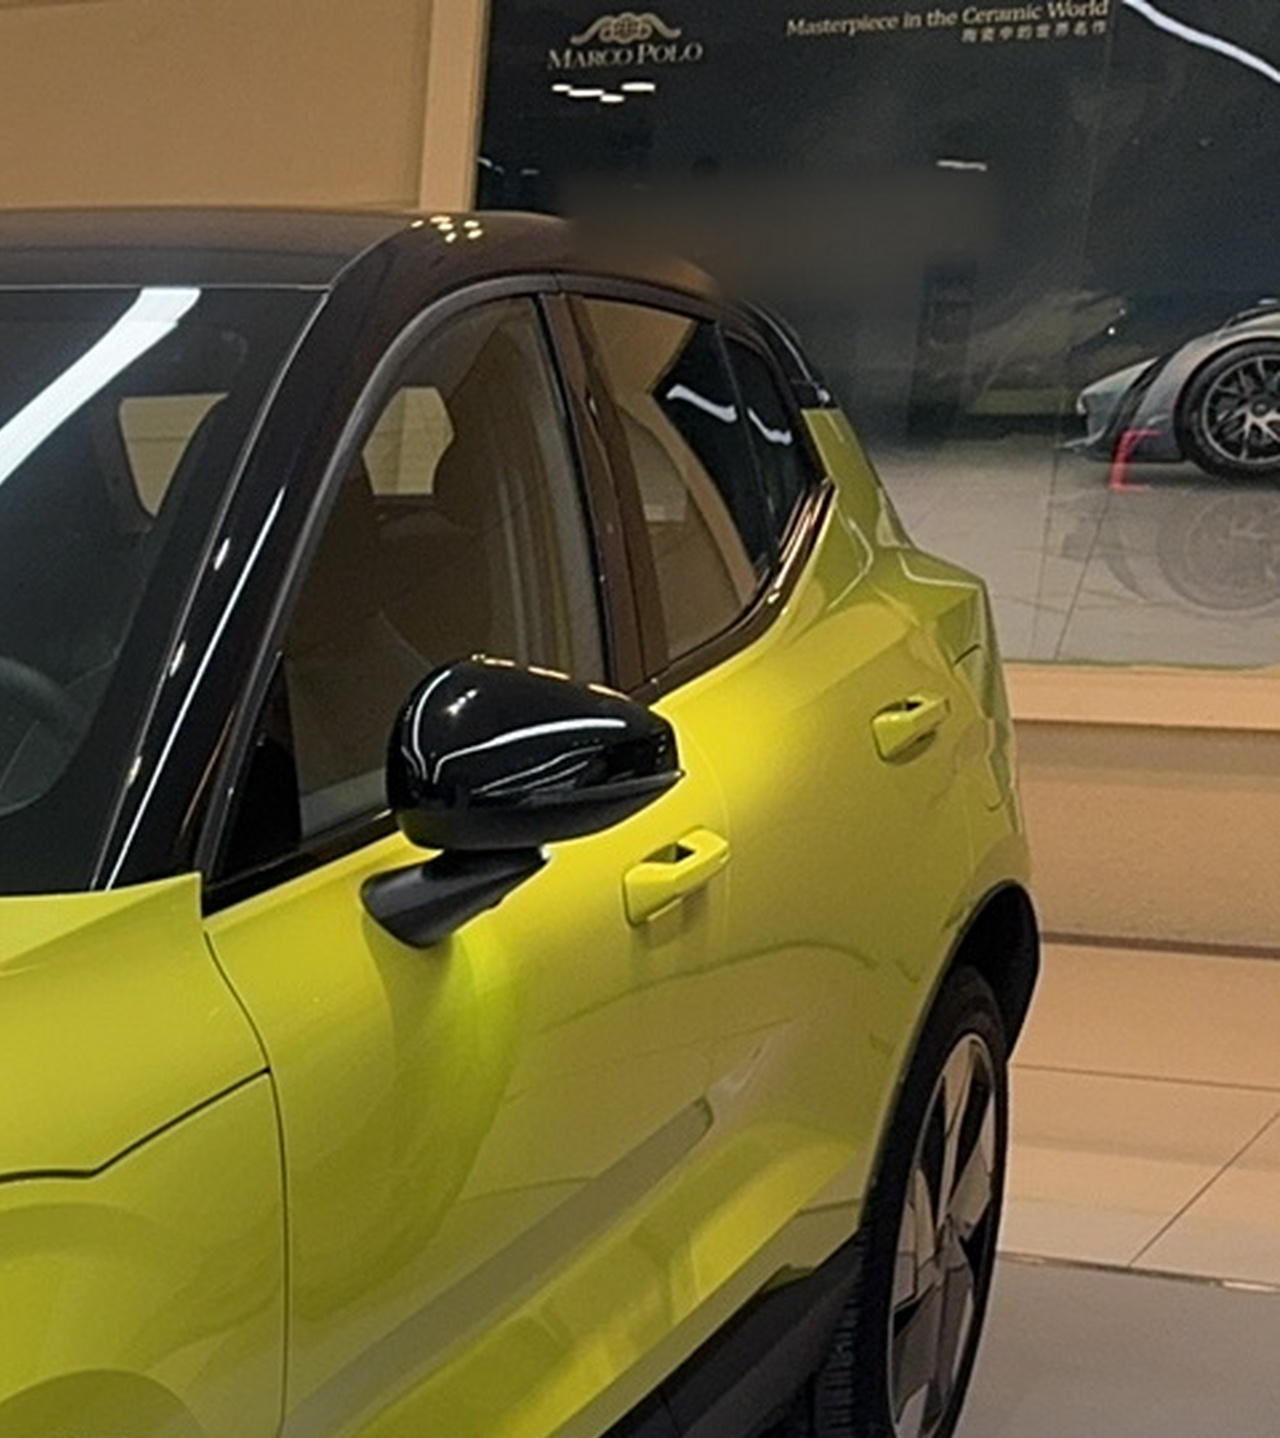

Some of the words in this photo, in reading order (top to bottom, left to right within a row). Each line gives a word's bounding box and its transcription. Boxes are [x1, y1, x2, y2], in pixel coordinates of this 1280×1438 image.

[786, 15, 900, 37] Masterpiece
[902, 11, 922, 29] in
[927, 8, 958, 27] the
[962, 4, 1041, 25] Ceramic
[1047, 0, 1109, 18] World
